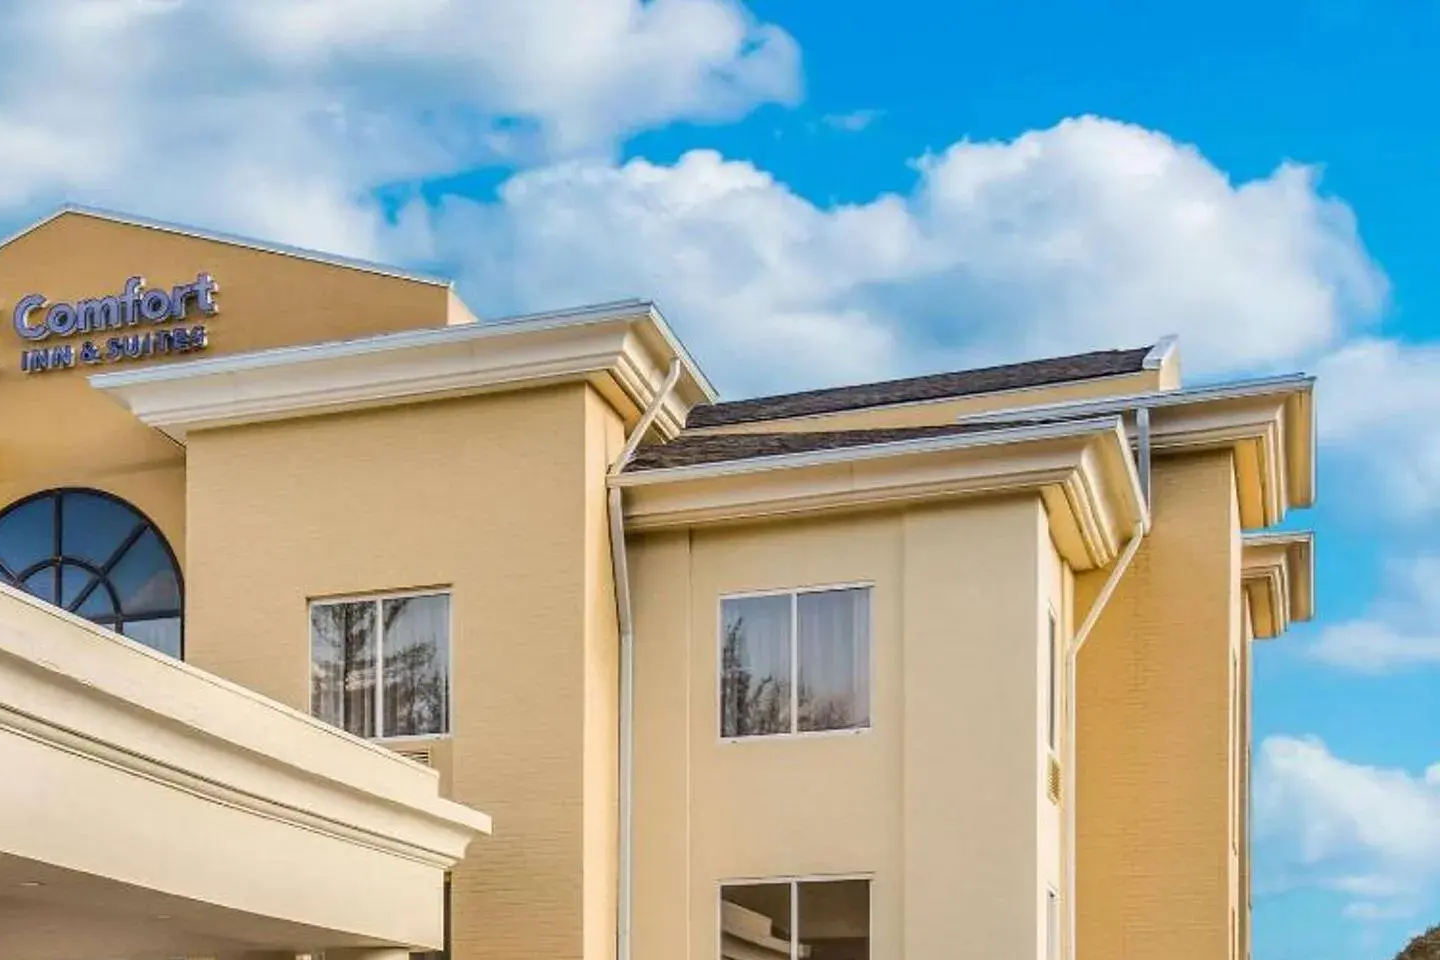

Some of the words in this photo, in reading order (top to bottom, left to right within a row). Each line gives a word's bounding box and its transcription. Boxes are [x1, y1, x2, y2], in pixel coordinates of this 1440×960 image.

[13, 272, 219, 340] Comfort
[20, 345, 75, 373] INN
[80, 340, 102, 364] &
[106, 325, 209, 360] SUITES
